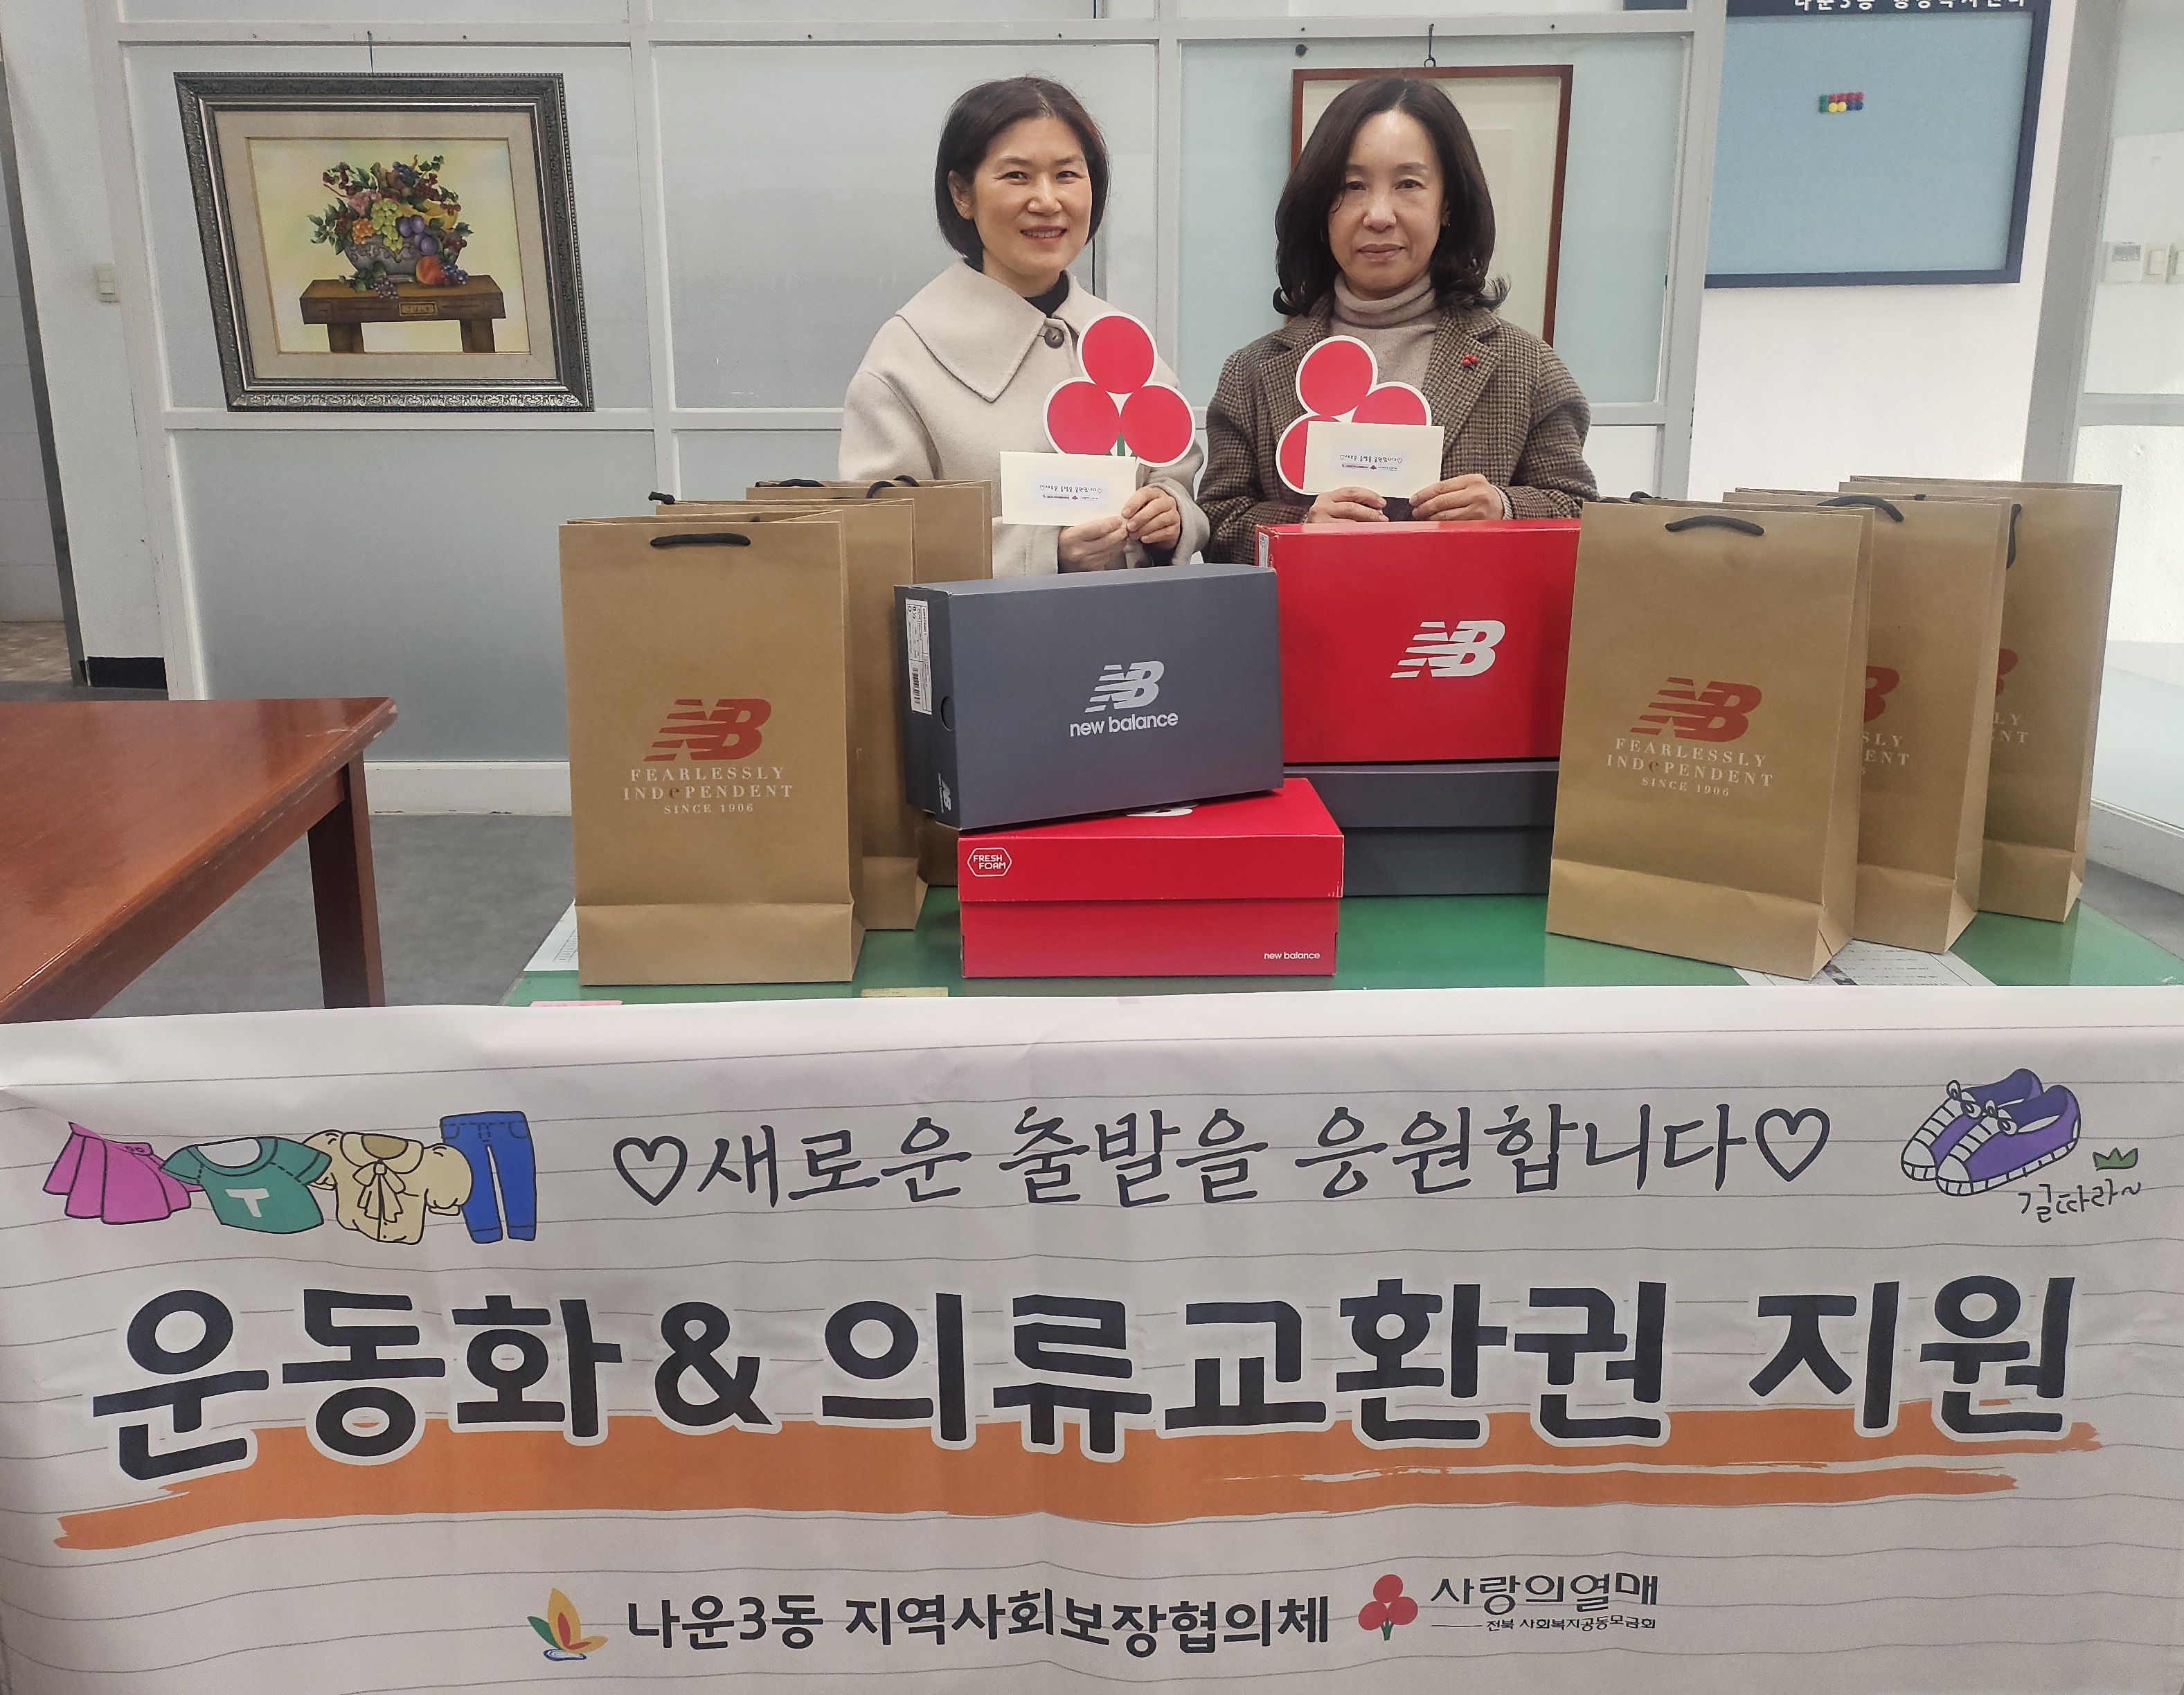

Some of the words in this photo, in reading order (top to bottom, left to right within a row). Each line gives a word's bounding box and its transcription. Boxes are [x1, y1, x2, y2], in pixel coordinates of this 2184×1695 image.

[1070, 720, 1105, 737] new
[1108, 712, 1179, 733] balance
[1615, 737, 1766, 768] FEARLESSLY
[630, 766, 785, 782] FEARLESSLY
[1642, 777, 1688, 791] SINCE
[1697, 784, 1730, 796] 1906
[663, 803, 712, 814] SINCE
[721, 802, 754, 814] 1906
[973, 854, 1003, 863] FRESH
[978, 861, 1006, 870] FOAM
[1283, 951, 1321, 960] balance
[697, 1117, 972, 1208] 새로운
[999, 1106, 1269, 1208] 출발을
[1294, 1103, 1748, 1199] 응원합니다
[821, 1277, 1667, 1454] 의류교환권
[1748, 1275, 2075, 1434] 지원
[1431, 1572, 1658, 1615] 사랑의열매
[627, 1595, 824, 1650] 나운3동
[845, 1587, 1328, 1658] 지역사회보장협의체
[1486, 1618, 1514, 1631] 전북
[1519, 1615, 1656, 1632] 사회복지공동모금회
